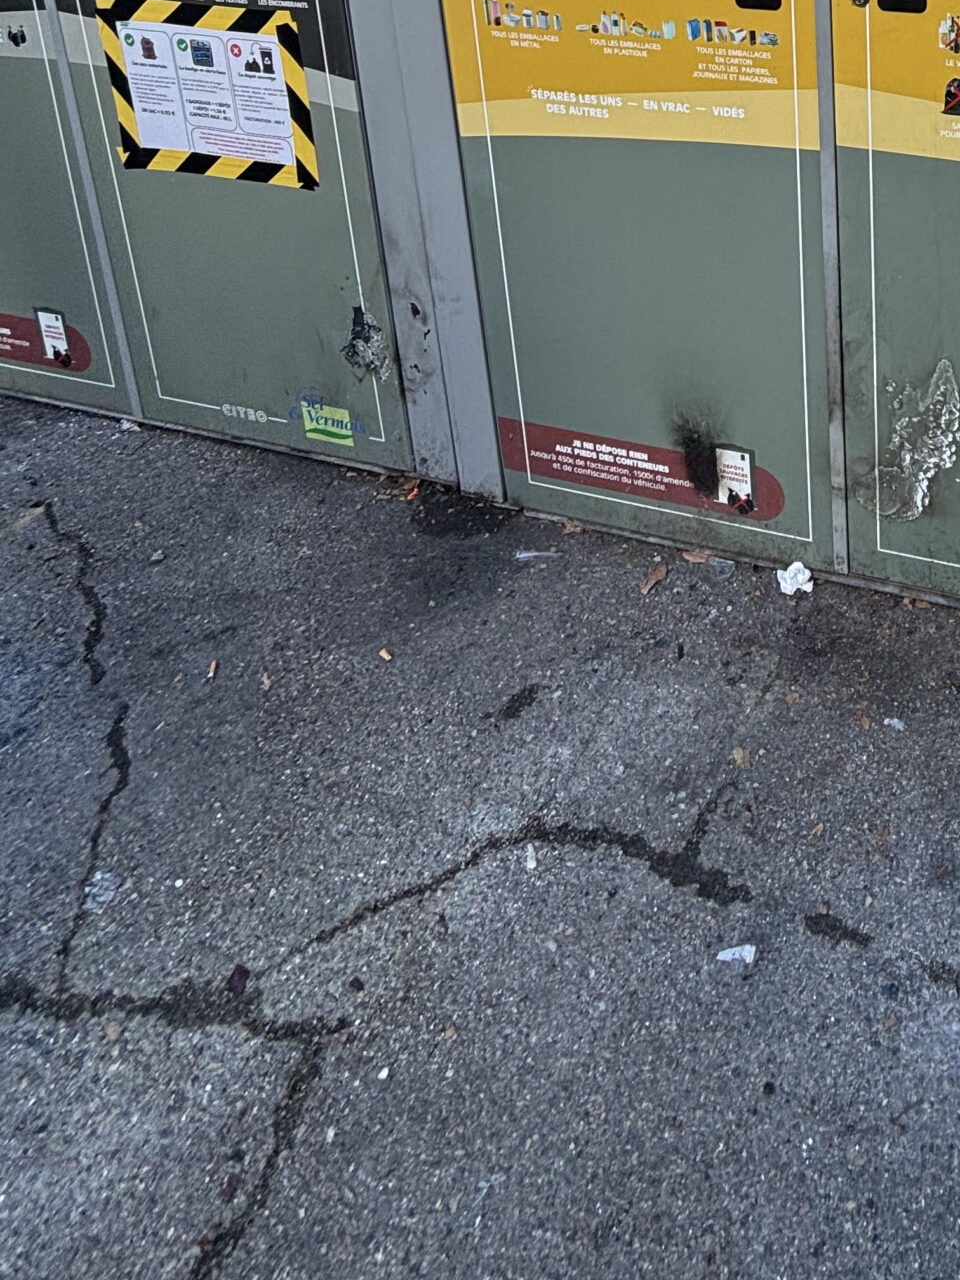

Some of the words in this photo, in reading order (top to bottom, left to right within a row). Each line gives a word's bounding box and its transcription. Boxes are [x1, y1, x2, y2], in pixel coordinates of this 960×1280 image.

[269, 0, 308, 8] ENCOMBRANTS
[491, 30, 507, 39] TOUS
[508, 32, 519, 40] LES
[520, 33, 559, 42] EMBALLAGES
[619, 40, 661, 50] EMBALLAGES
[614, 48, 648, 57] PLASTIQUE
[728, 49, 771, 59] EMBALLAGES
[726, 57, 753, 66] CARTON
[693, 71, 728, 80] JOURNAUX
[739, 75, 778, 84] MAGAZINES
[531, 89, 576, 102] SÉPARÉS
[578, 94, 597, 104] LES
[600, 96, 622, 107] UNS
[546, 103, 566, 114] DES
[568, 105, 609, 119] AUTRES
[643, 100, 658, 110] EN
[660, 101, 690, 113] VRAC
[712, 105, 745, 118] VIDÉS
[308, 410, 366, 433] Vermois
[572, 440, 581, 448] JE
[583, 442, 595, 450] NE
[596, 443, 628, 457] DÉPOSE
[629, 450, 649, 461] RIEN
[555, 445, 572, 455] AUX
[574, 448, 597, 459] PIEDS
[599, 453, 615, 462] DES
[616, 458, 670, 473] CONTENEURS
[552, 462, 561, 470] et
[562, 464, 573, 472] de
[574, 466, 620, 482] confiscation
[621, 475, 632, 484] du
[575, 458, 585, 466] de
[587, 461, 631, 476] facturation,
